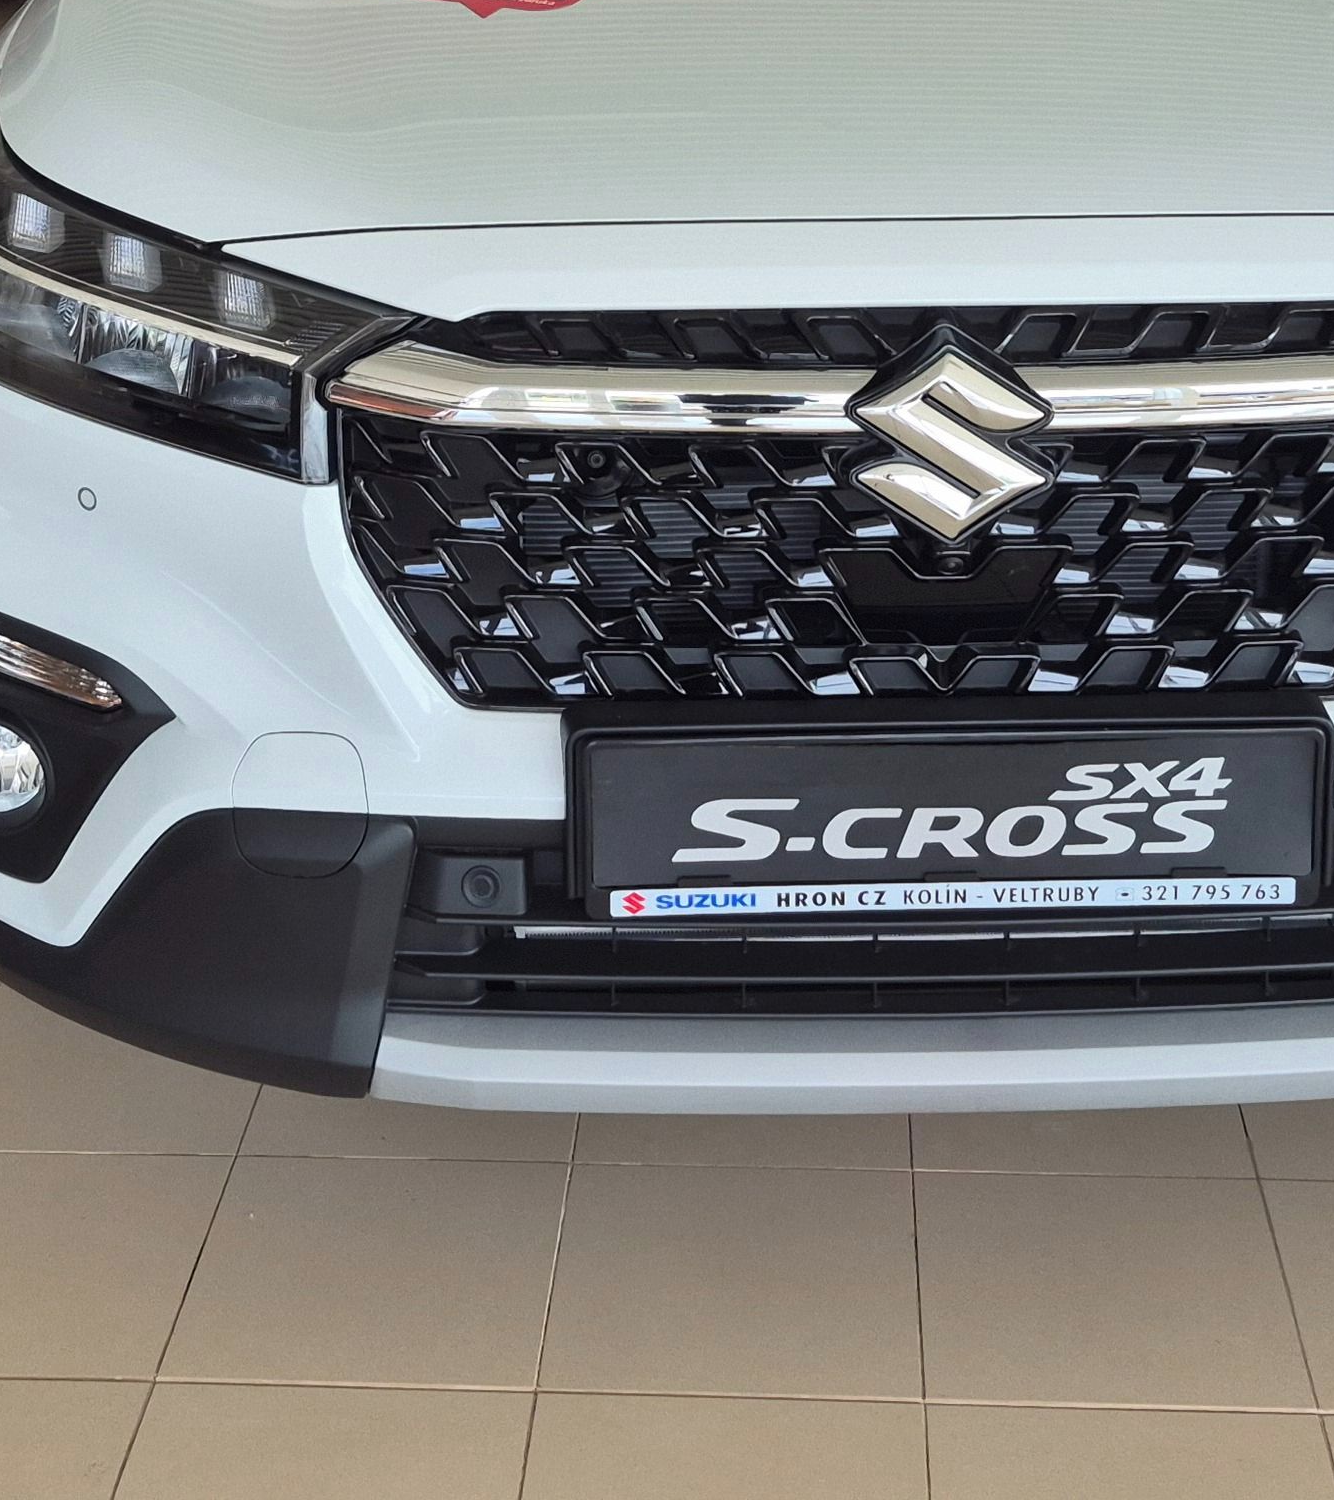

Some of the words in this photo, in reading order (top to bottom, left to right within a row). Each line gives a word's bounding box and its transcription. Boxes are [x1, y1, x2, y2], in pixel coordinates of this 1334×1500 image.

[1048, 756, 1233, 802] SX4
[671, 797, 1228, 863] S-CROSS
[656, 893, 756, 910] SUZUKI
[777, 890, 847, 908] HRON
[857, 890, 888, 906] CZ
[903, 884, 968, 906] KOLÍN
[992, 886, 1100, 904] VELTRUBY
[1142, 885, 1179, 902] 321
[1192, 884, 1232, 901] 795
[1241, 884, 1281, 900] 763
